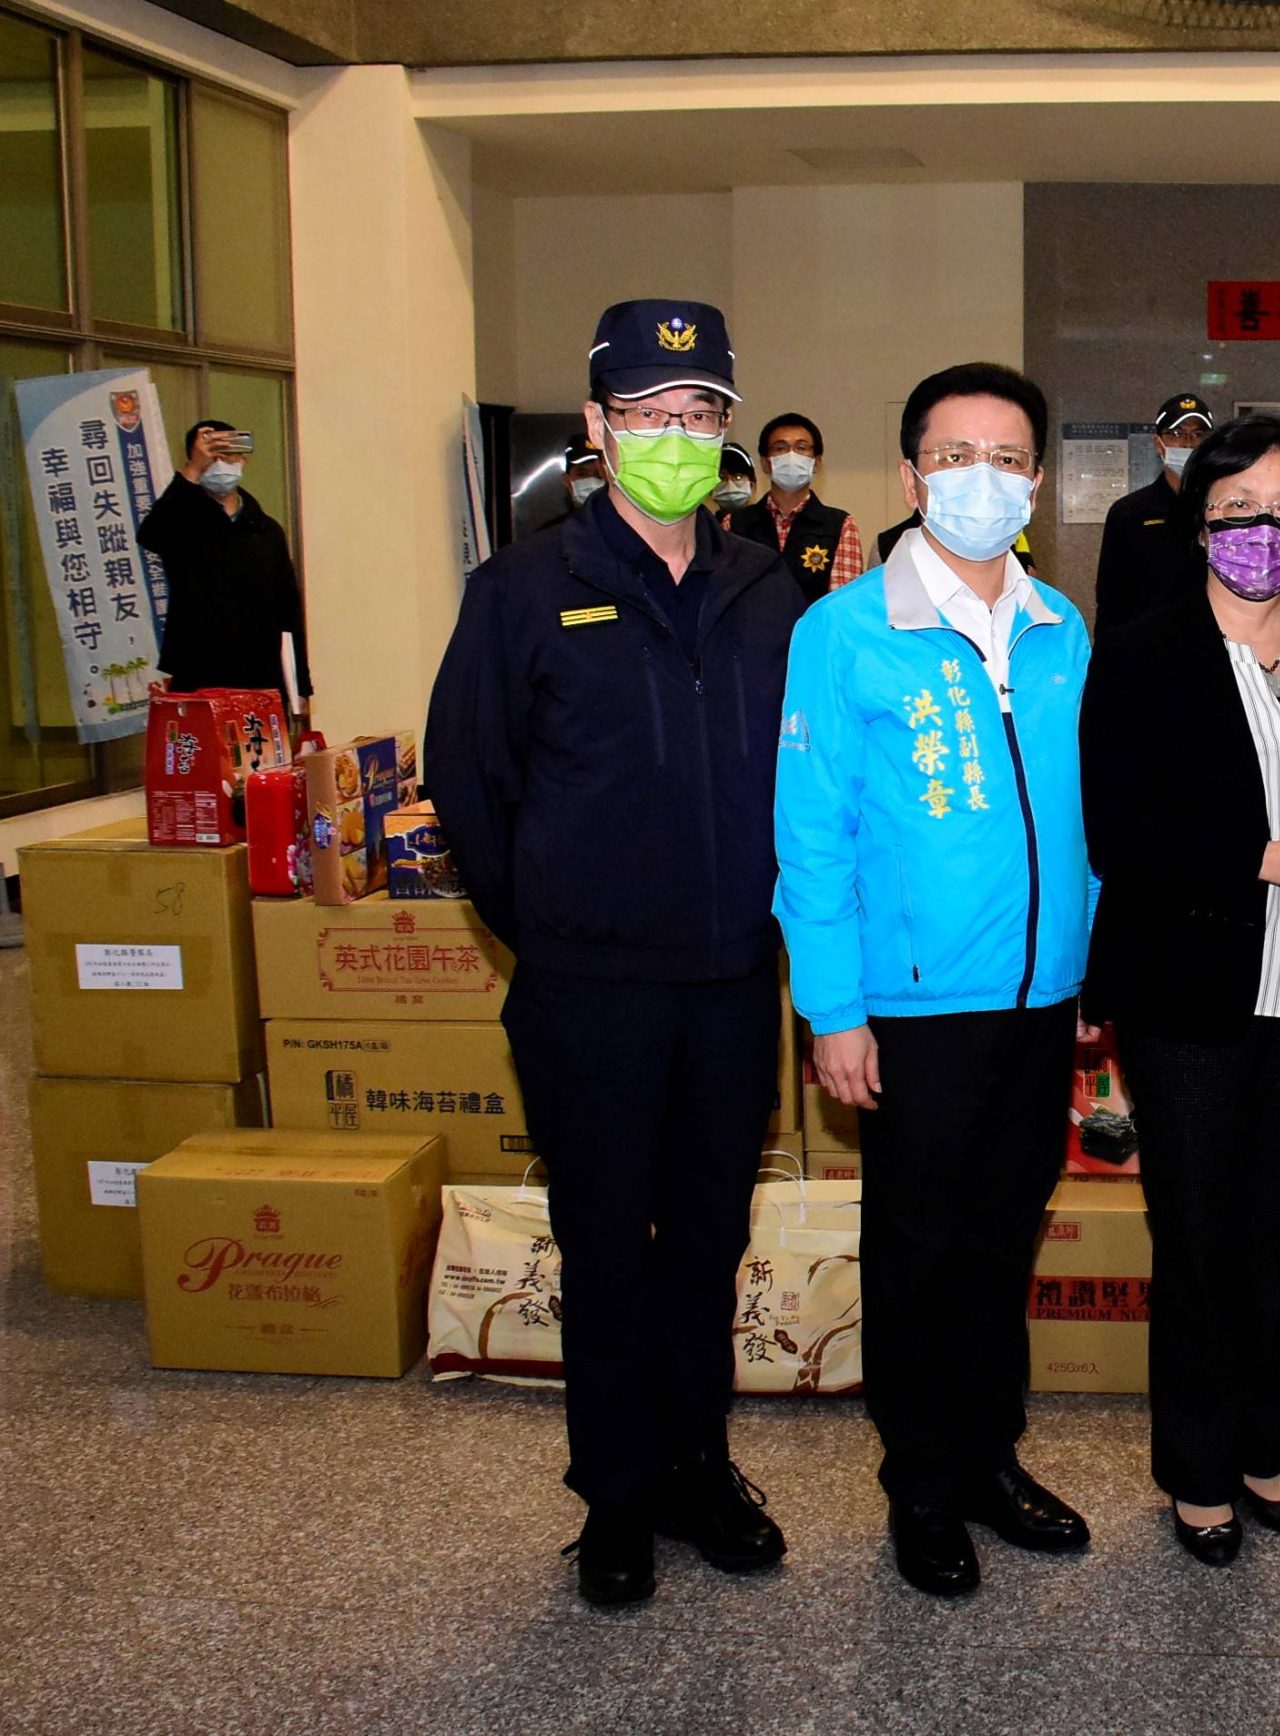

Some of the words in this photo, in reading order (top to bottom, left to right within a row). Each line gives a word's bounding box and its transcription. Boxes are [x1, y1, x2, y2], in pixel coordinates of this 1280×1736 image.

[40, 447, 104, 676] 幸福與您相守。
[902, 688, 955, 819] 洪榮章
[941, 658, 990, 811] 彰化縣副縣長
[333, 944, 480, 972] 英式花園午茶
[365, 1089, 506, 1115] 韓味海苔禮盒
[176, 1236, 343, 1293] Prague
[739, 1255, 777, 1364] 新義發
[1037, 1307, 1112, 1321] PREMIUM
